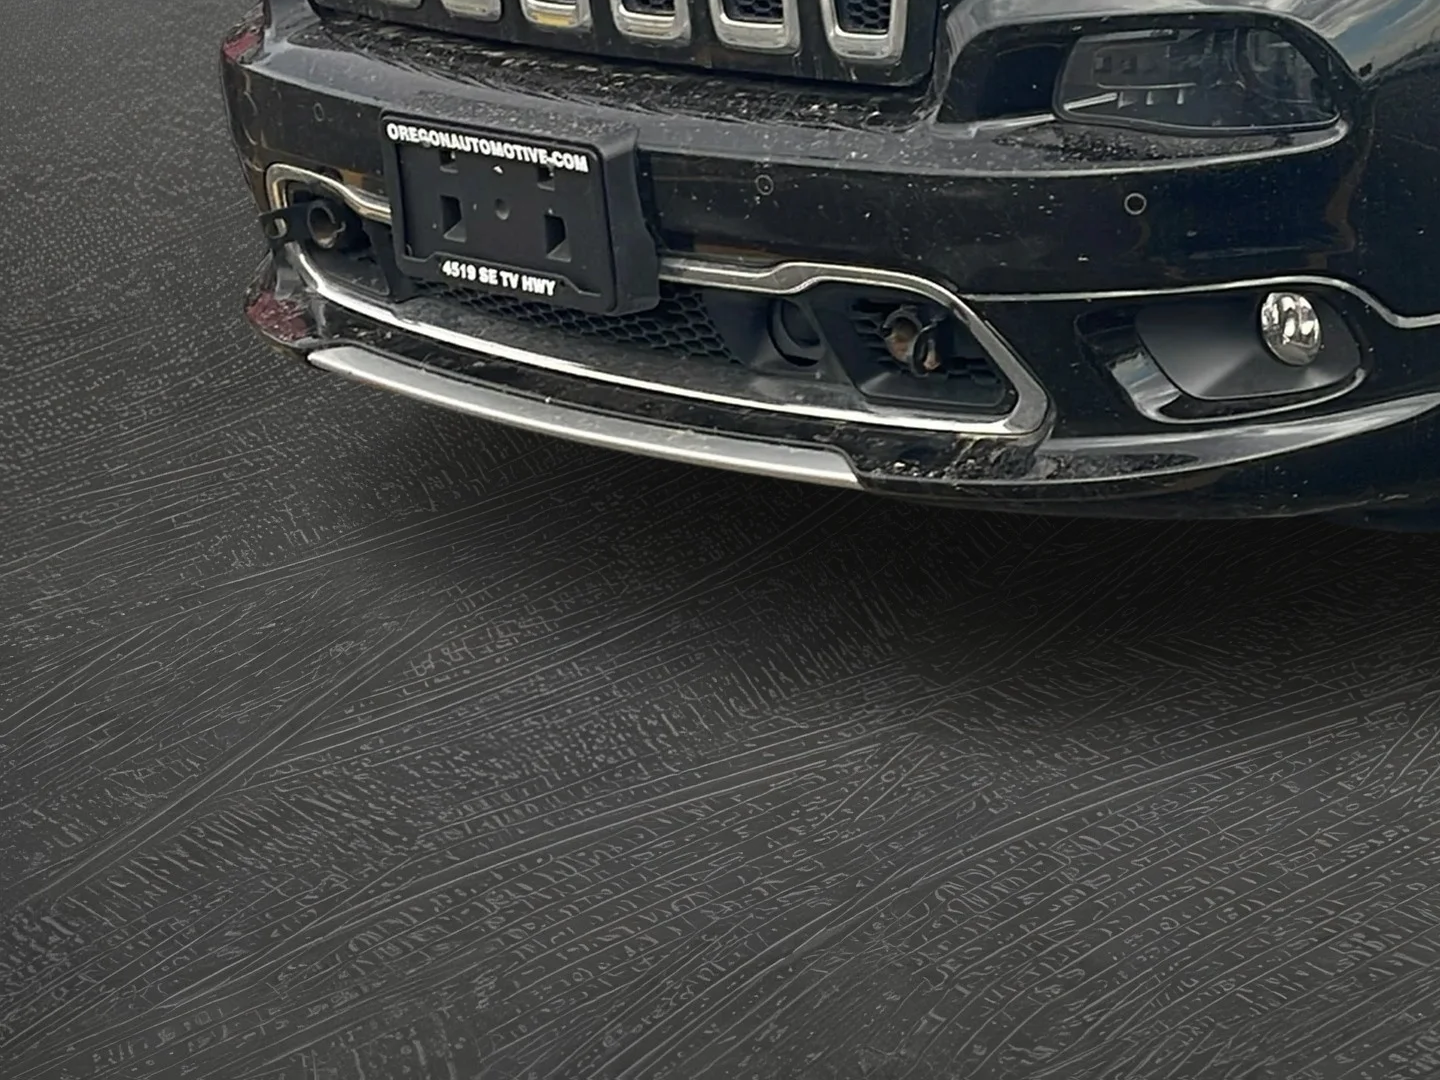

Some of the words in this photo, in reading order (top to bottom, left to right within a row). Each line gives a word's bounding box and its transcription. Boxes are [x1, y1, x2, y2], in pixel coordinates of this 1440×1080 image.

[442, 260, 477, 280] 4519
[478, 266, 499, 286] SE
[499, 270, 519, 289] TV
[521, 275, 556, 296] HWY
